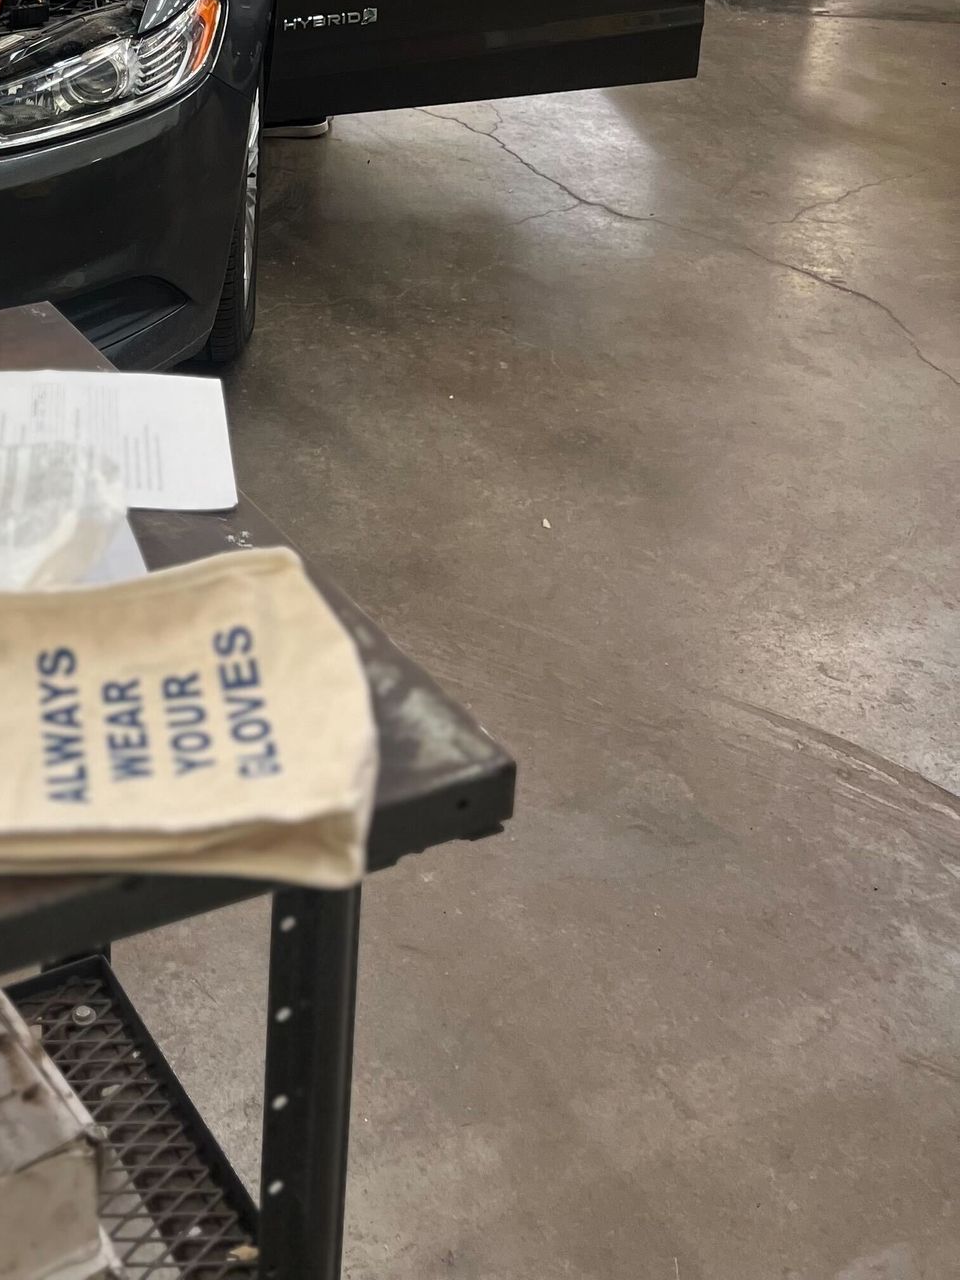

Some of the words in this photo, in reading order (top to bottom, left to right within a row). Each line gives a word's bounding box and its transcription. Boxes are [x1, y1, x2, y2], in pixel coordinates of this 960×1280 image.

[283, 12, 361, 31] HYBRID
[36, 646, 91, 805] ALWAYS
[102, 677, 154, 783] WEAR
[162, 672, 217, 777] YOUR
